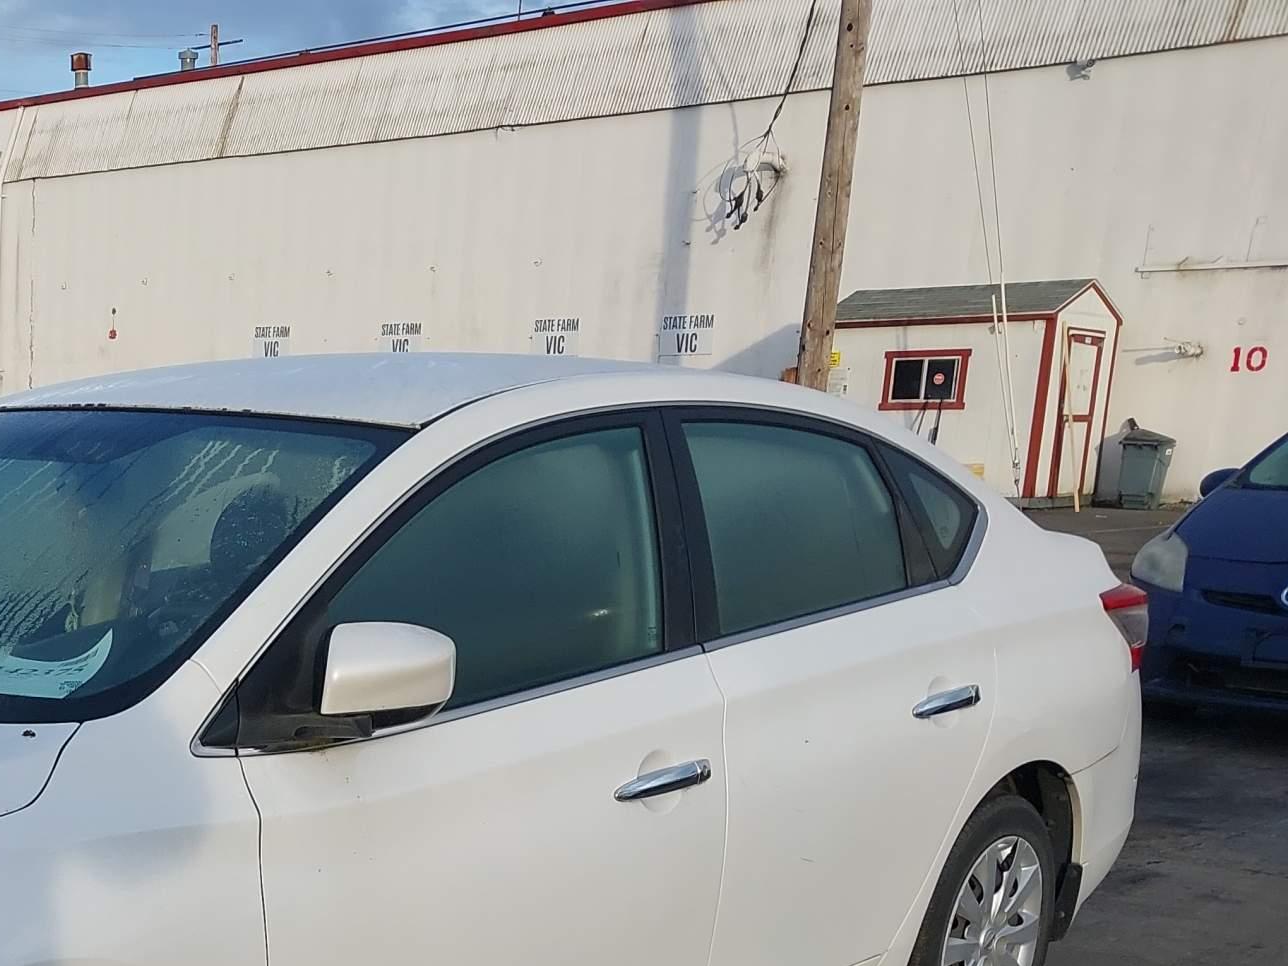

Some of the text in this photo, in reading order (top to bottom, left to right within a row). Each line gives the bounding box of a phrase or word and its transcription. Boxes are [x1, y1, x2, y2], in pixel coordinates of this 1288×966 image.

[381, 322, 422, 337] STATE FARM
[534, 318, 579, 333] STATE FARM
[663, 314, 714, 331] STATE FARM
[255, 326, 290, 338] STATE FARM
[264, 340, 279, 358] VIC
[392, 338, 409, 353] VIC
[545, 335, 565, 355] VIC
[676, 332, 698, 353] VIC
[1230, 346, 1268, 372] 10
